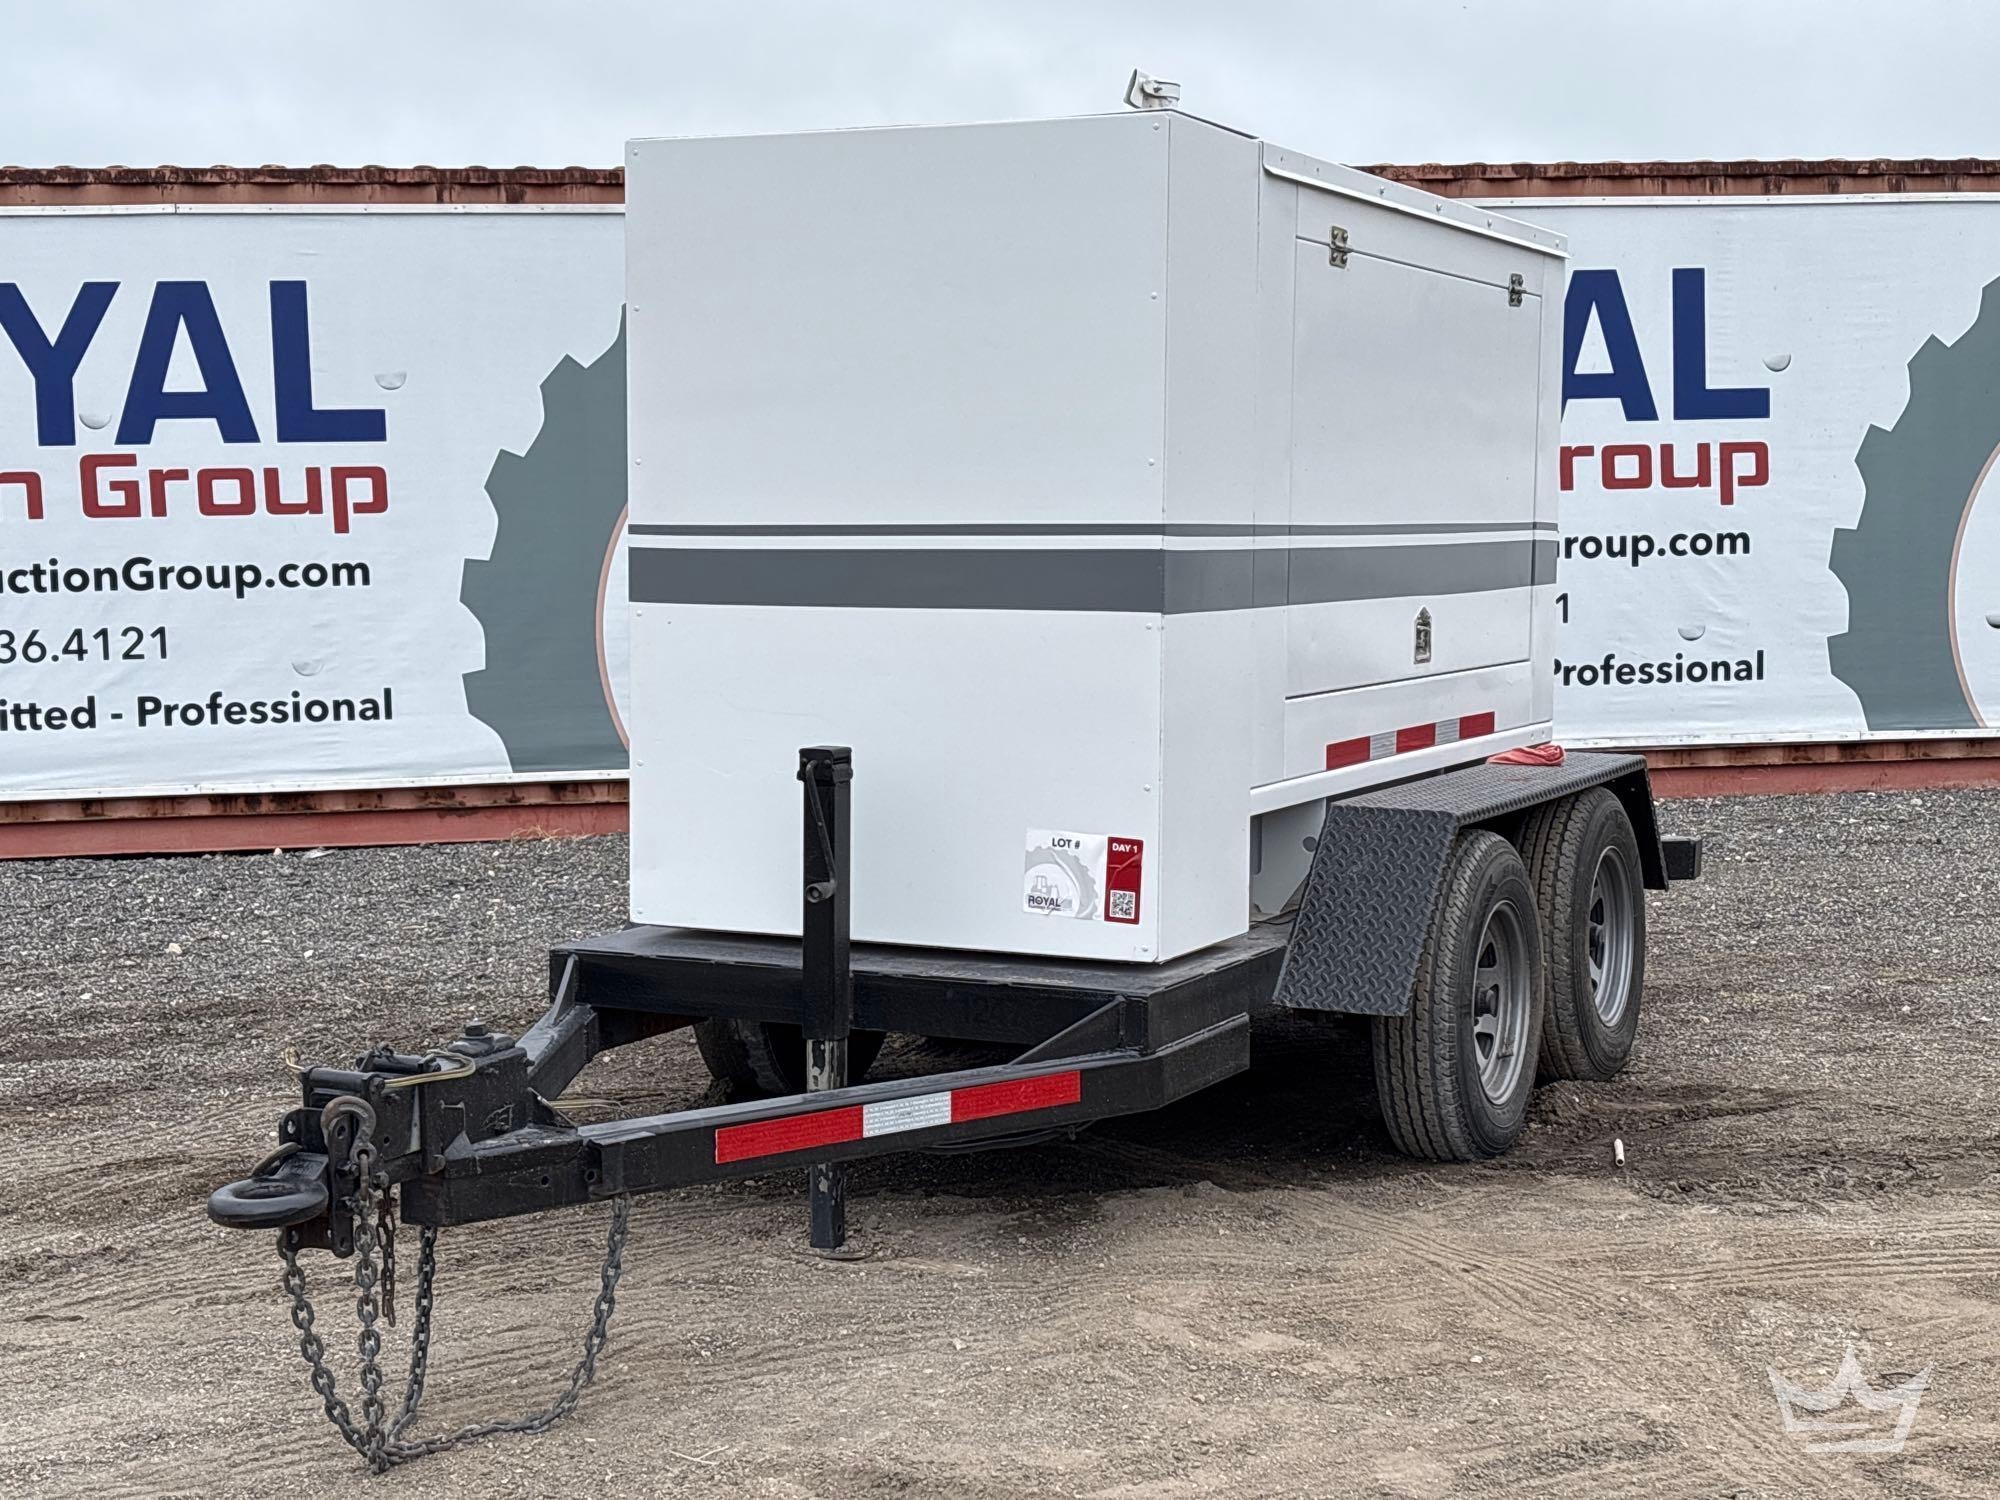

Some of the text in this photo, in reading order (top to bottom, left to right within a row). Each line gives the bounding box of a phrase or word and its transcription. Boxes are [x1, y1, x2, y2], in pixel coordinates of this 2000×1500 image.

[0, 280, 387, 446] YAL
[1560, 267, 1770, 422] AL
[80, 454, 388, 534] Group
[1559, 441, 1769, 506] roup
[1557, 530, 1751, 568] roup.com
[0, 556, 371, 599] ctionGroup.com
[137, 687, 393, 728] Professional
[1051, 837, 1073, 850] LOT
[1112, 843, 1138, 854] DAY 1
[1028, 895, 1062, 908] ROYAL
